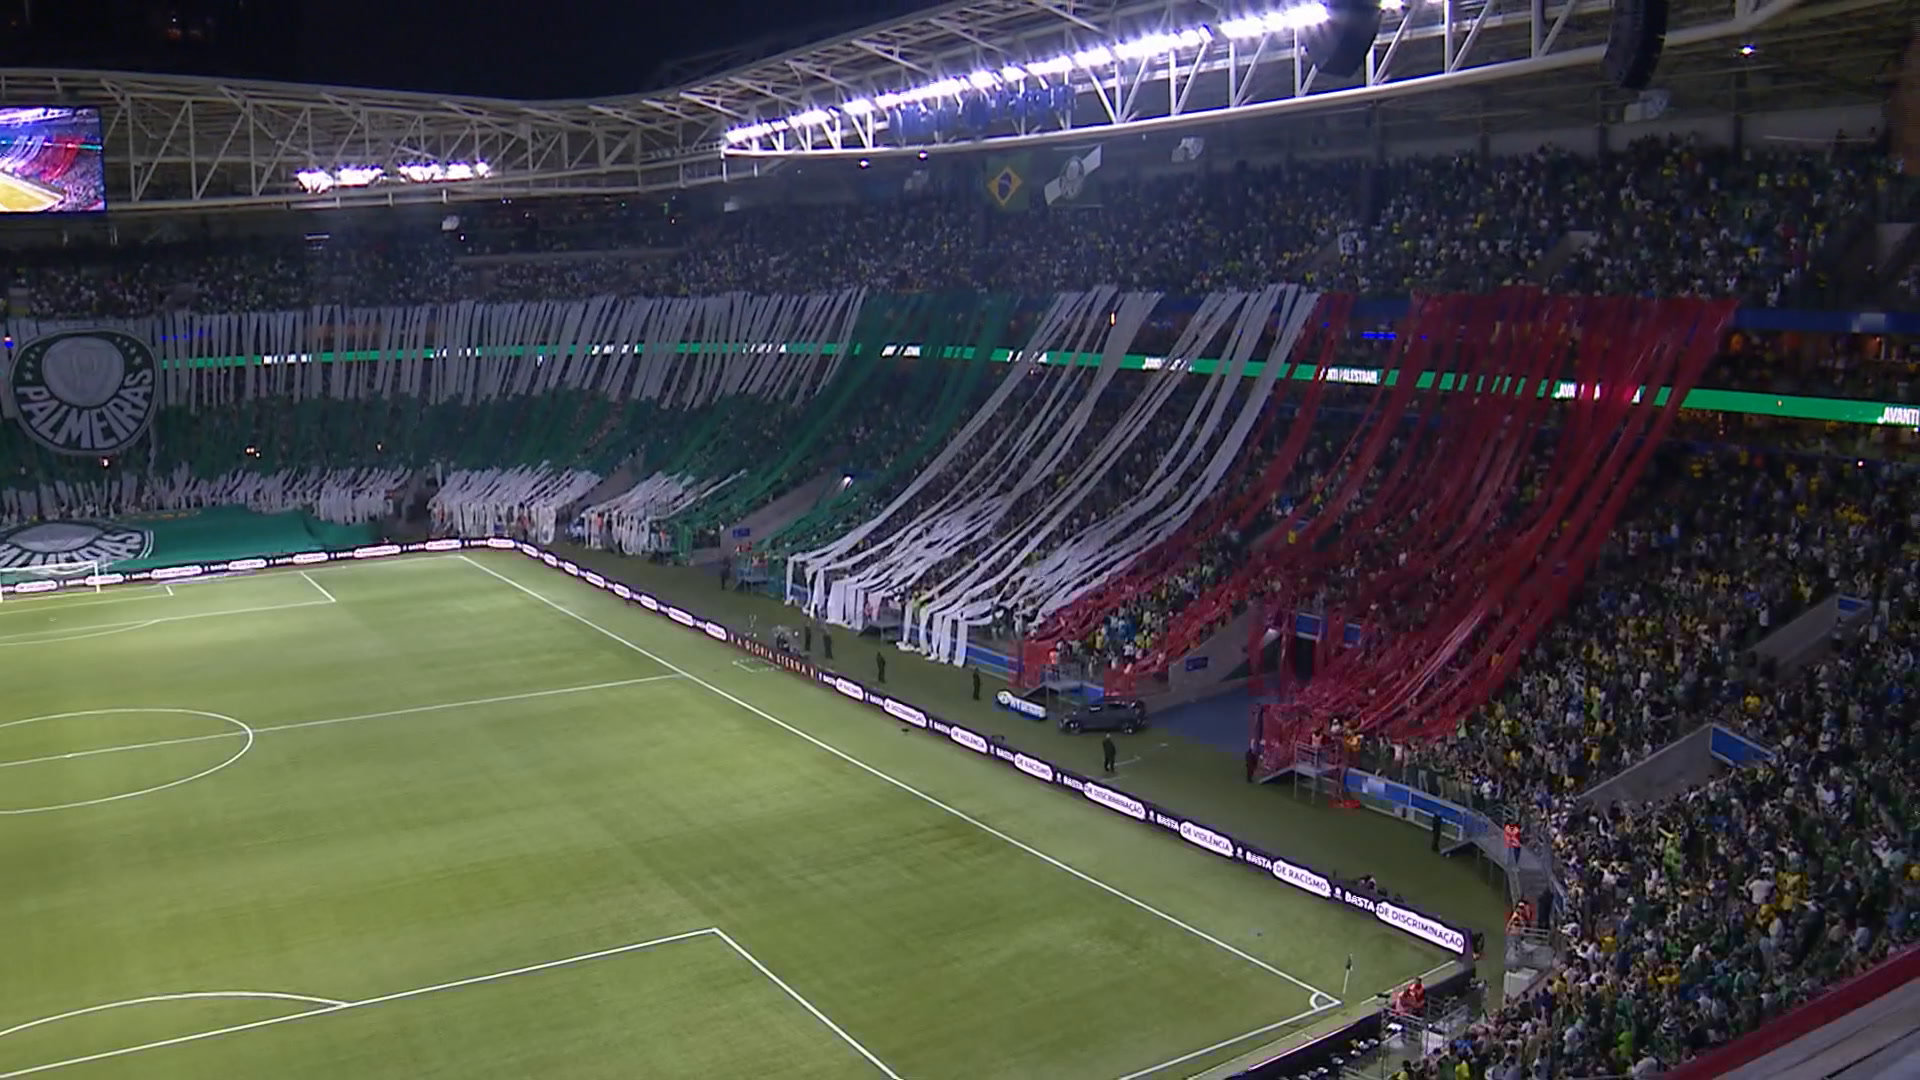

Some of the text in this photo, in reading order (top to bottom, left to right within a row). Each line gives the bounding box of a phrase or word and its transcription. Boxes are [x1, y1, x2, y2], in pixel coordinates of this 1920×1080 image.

[16, 368, 153, 449] PALMEIRAS
[1883, 406, 1920, 426] AVANTI
[1182, 825, 1191, 836] DE
[1193, 829, 1230, 852] VIOLÊNCIA
[1246, 851, 1327, 892] BASTA DE RACISMO
[1345, 891, 1463, 948] BASTA DE DISCRIMINAÇÃO
